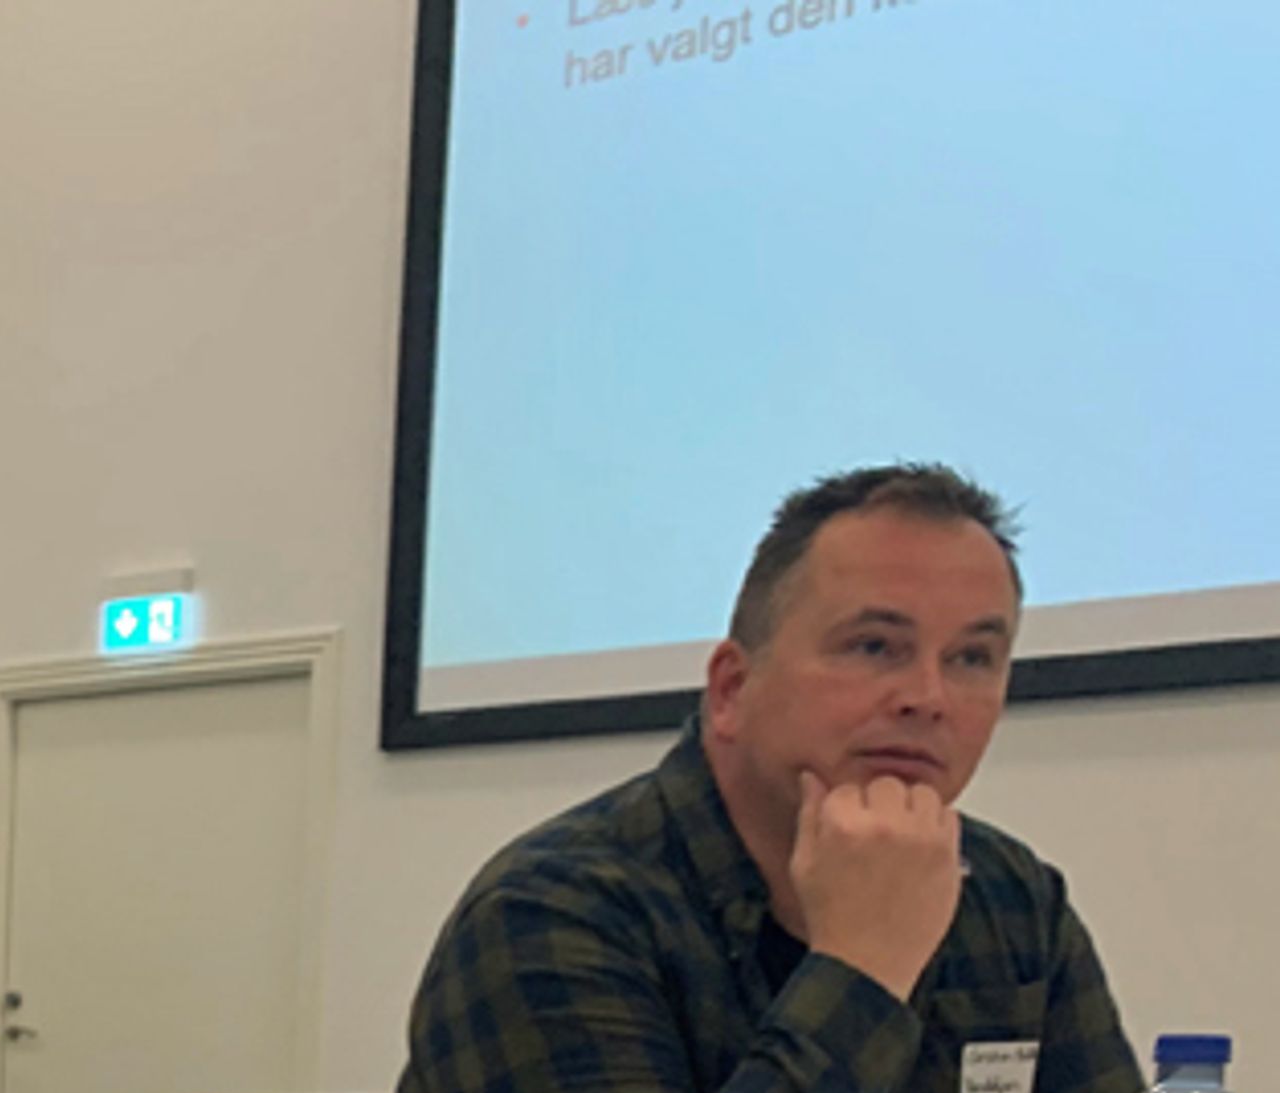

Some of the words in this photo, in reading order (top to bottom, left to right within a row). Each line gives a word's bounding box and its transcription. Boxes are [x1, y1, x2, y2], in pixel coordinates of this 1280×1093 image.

[562, 43, 635, 88] har
[645, 7, 754, 63] valgt
[767, 0, 855, 38] den
